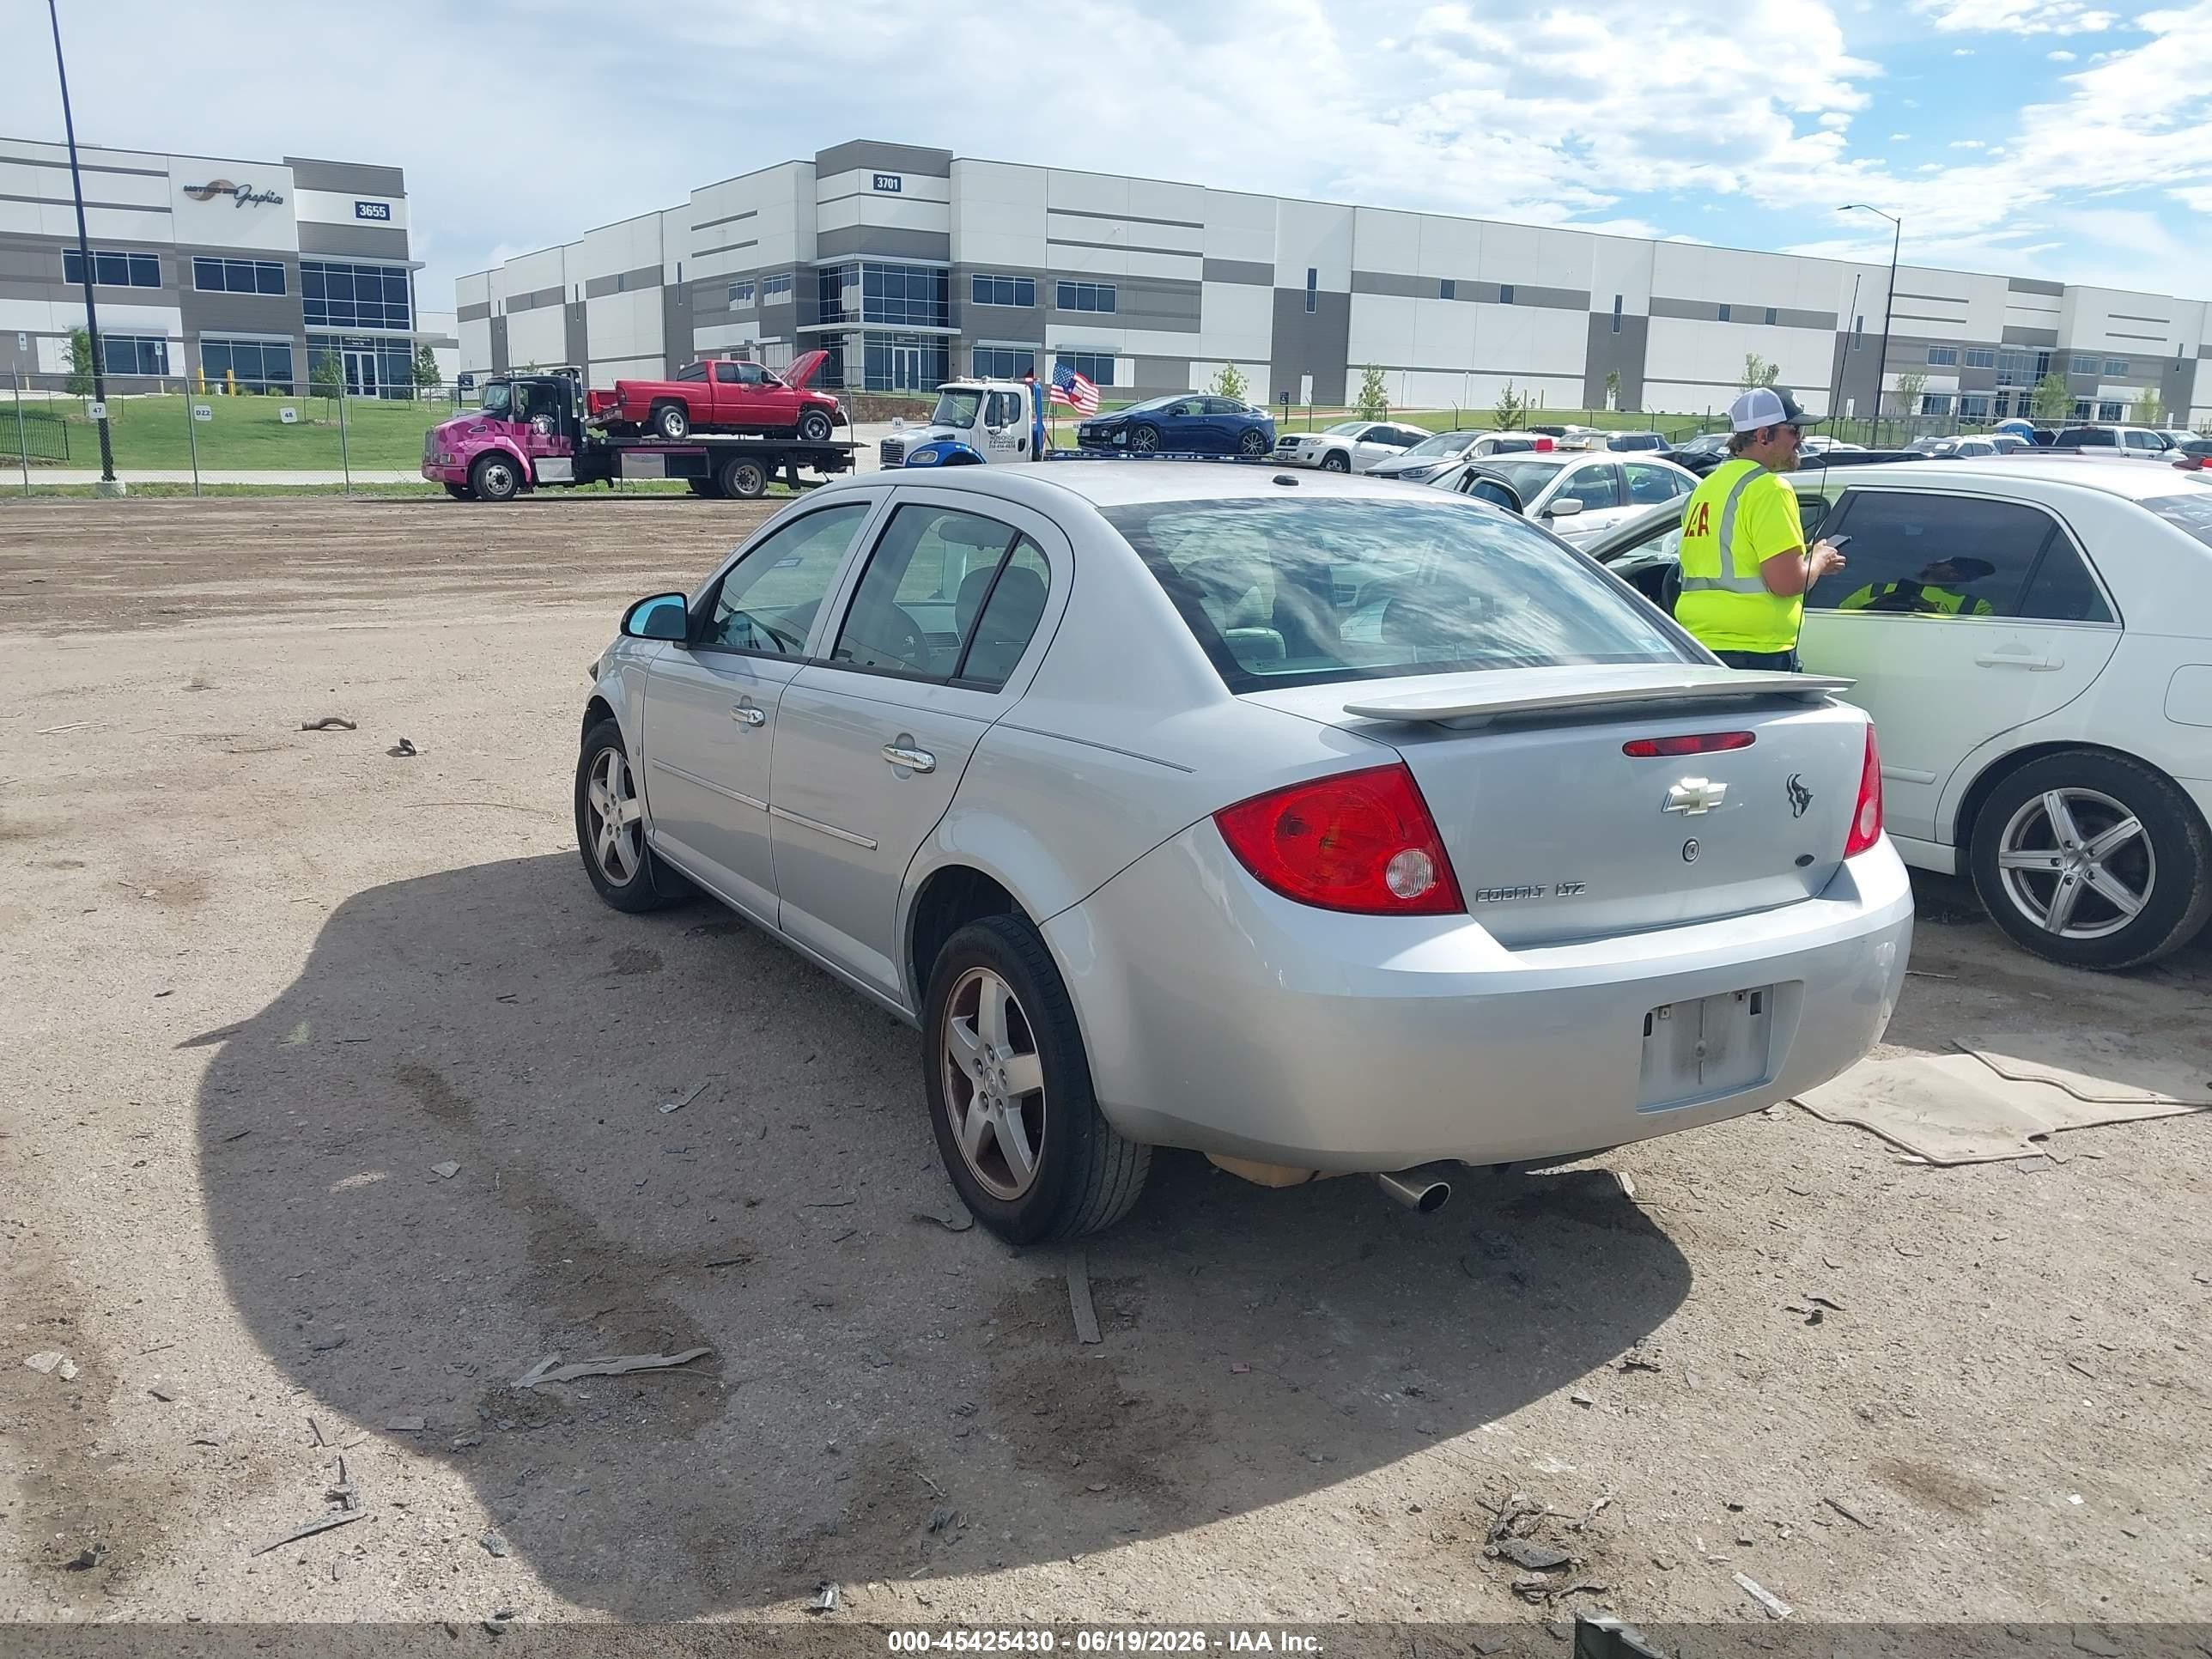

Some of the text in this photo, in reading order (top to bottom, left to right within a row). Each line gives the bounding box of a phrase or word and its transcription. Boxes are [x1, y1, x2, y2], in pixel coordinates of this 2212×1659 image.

[877, 177, 898, 190] 3701
[234, 184, 284, 209] Graphics
[359, 204, 386, 218] 3655
[1476, 881, 1587, 902] COBALT LTZ
